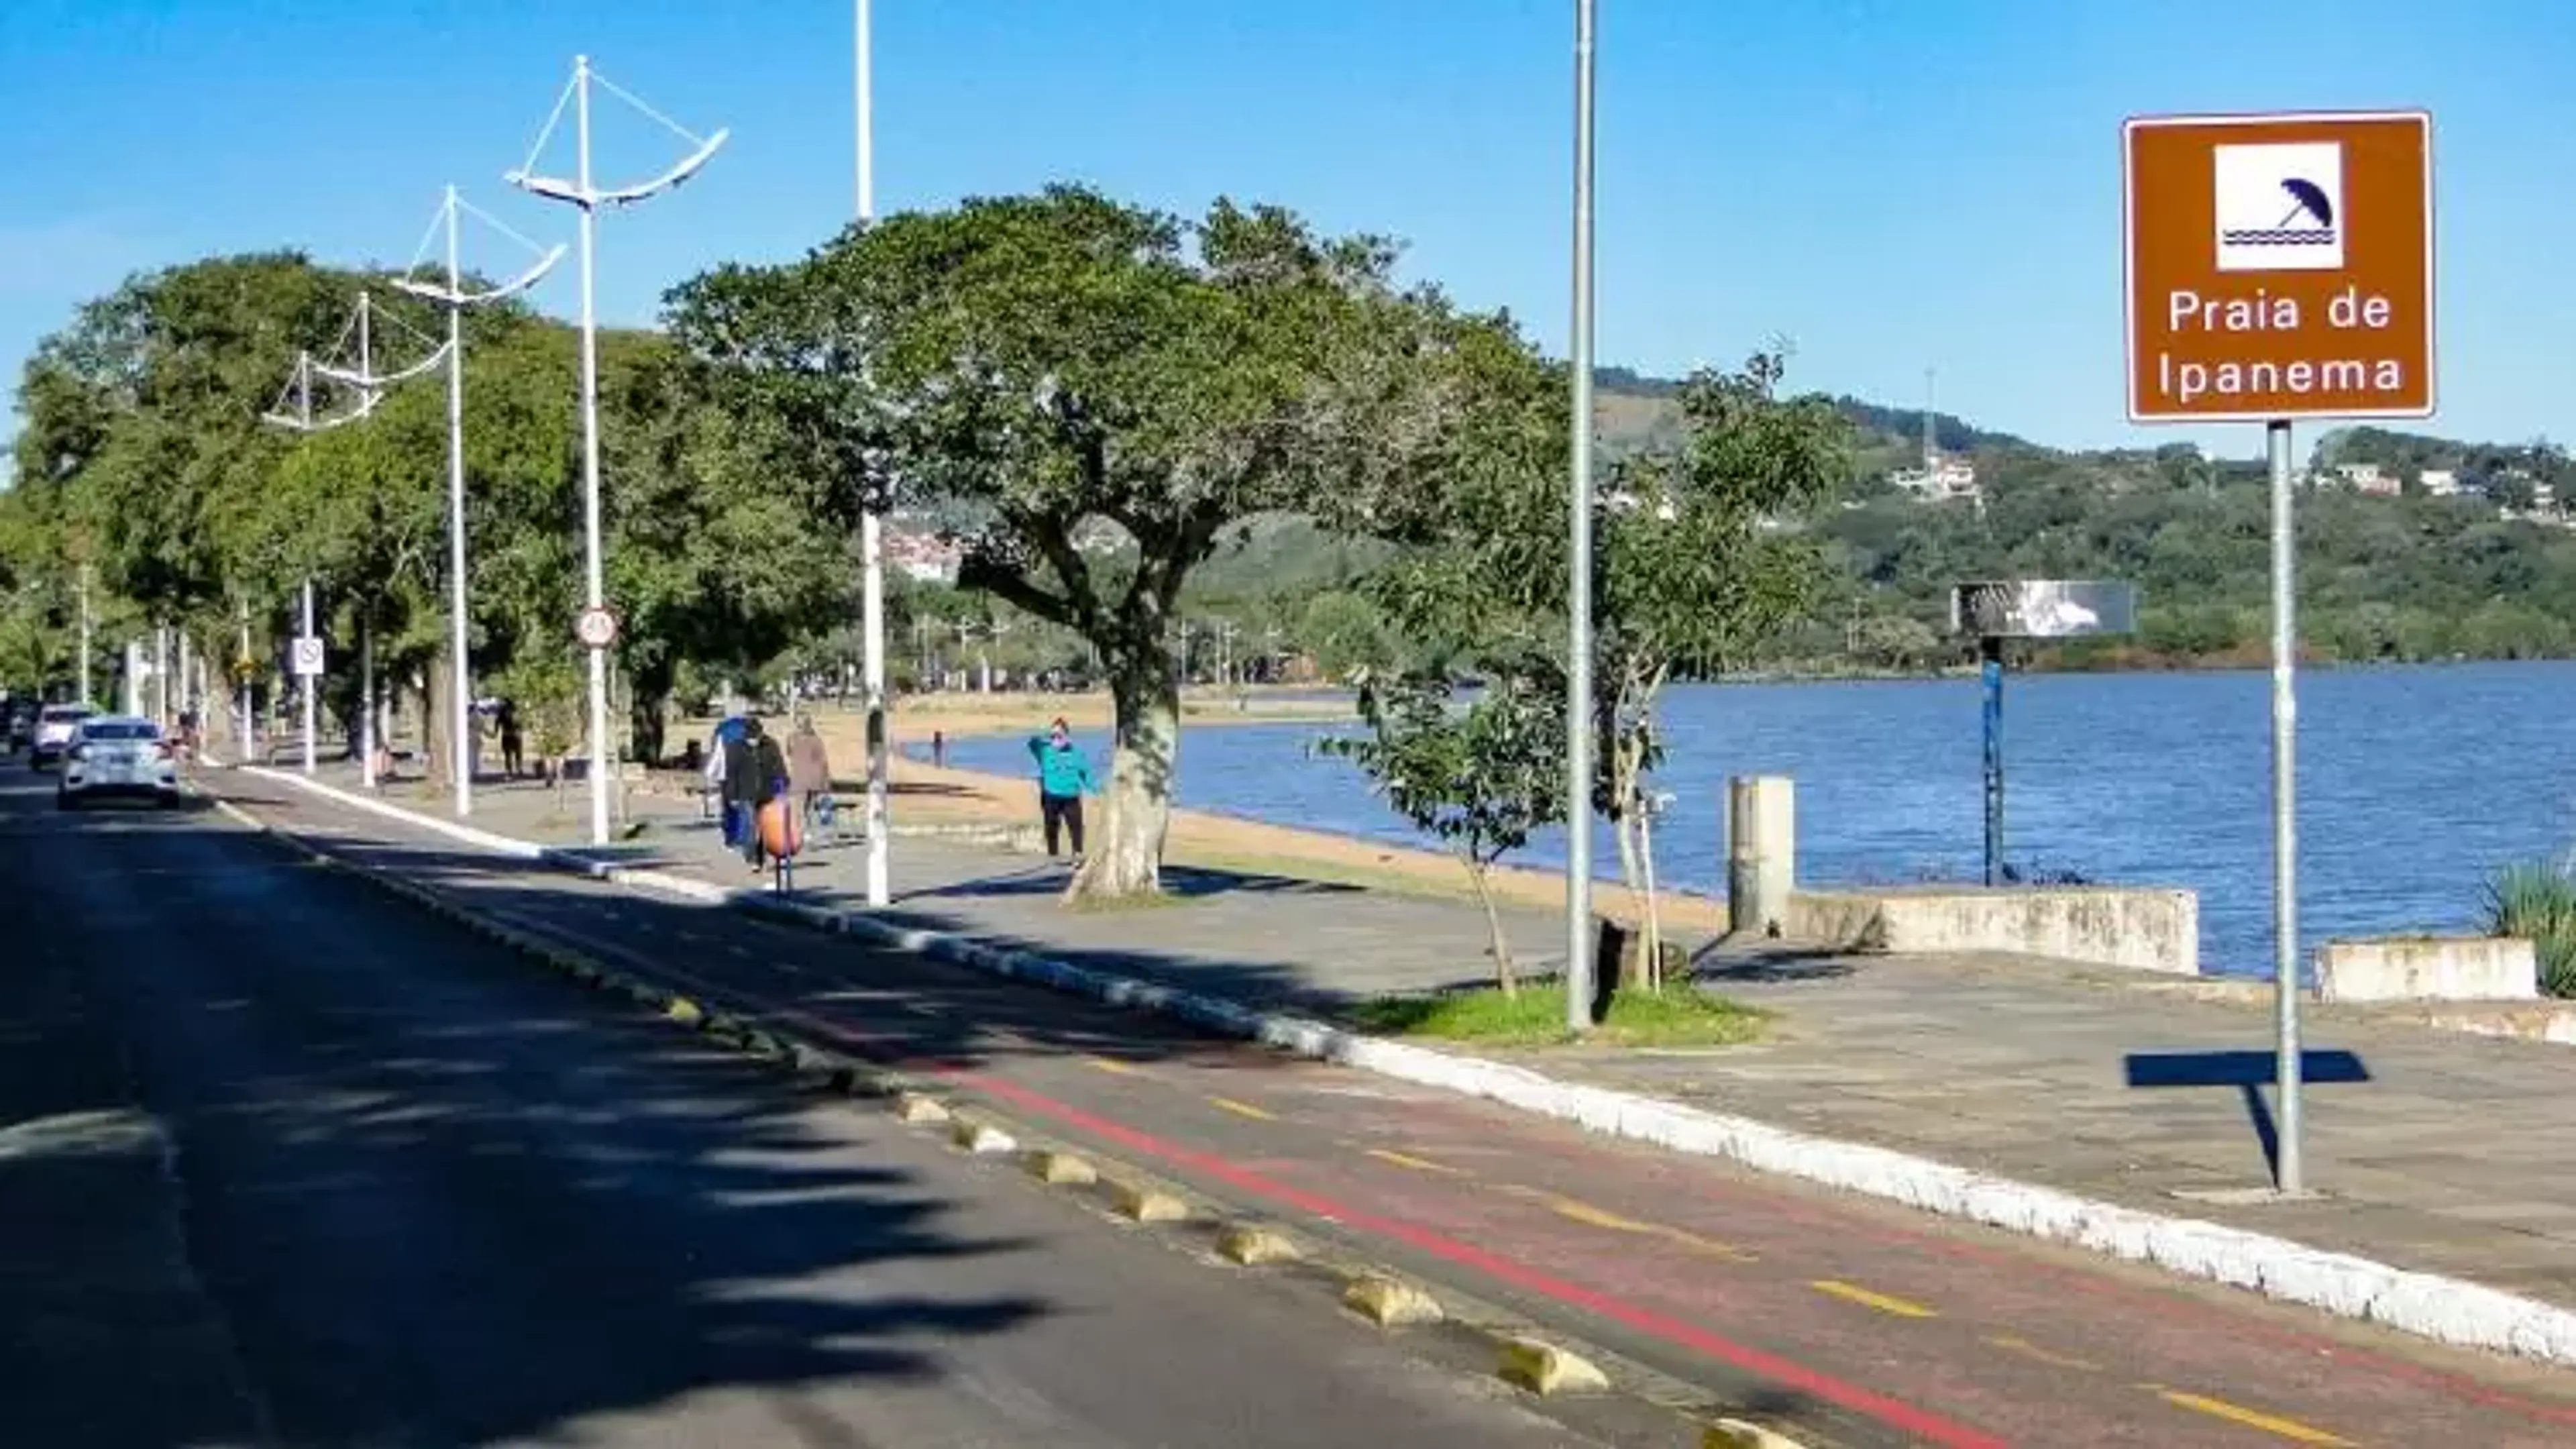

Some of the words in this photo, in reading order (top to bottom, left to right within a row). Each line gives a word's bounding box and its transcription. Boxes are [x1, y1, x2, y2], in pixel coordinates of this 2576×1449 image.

[2169, 288, 2299, 331] Praia
[2328, 286, 2391, 328] de
[2159, 353, 2402, 403] Ipanema
